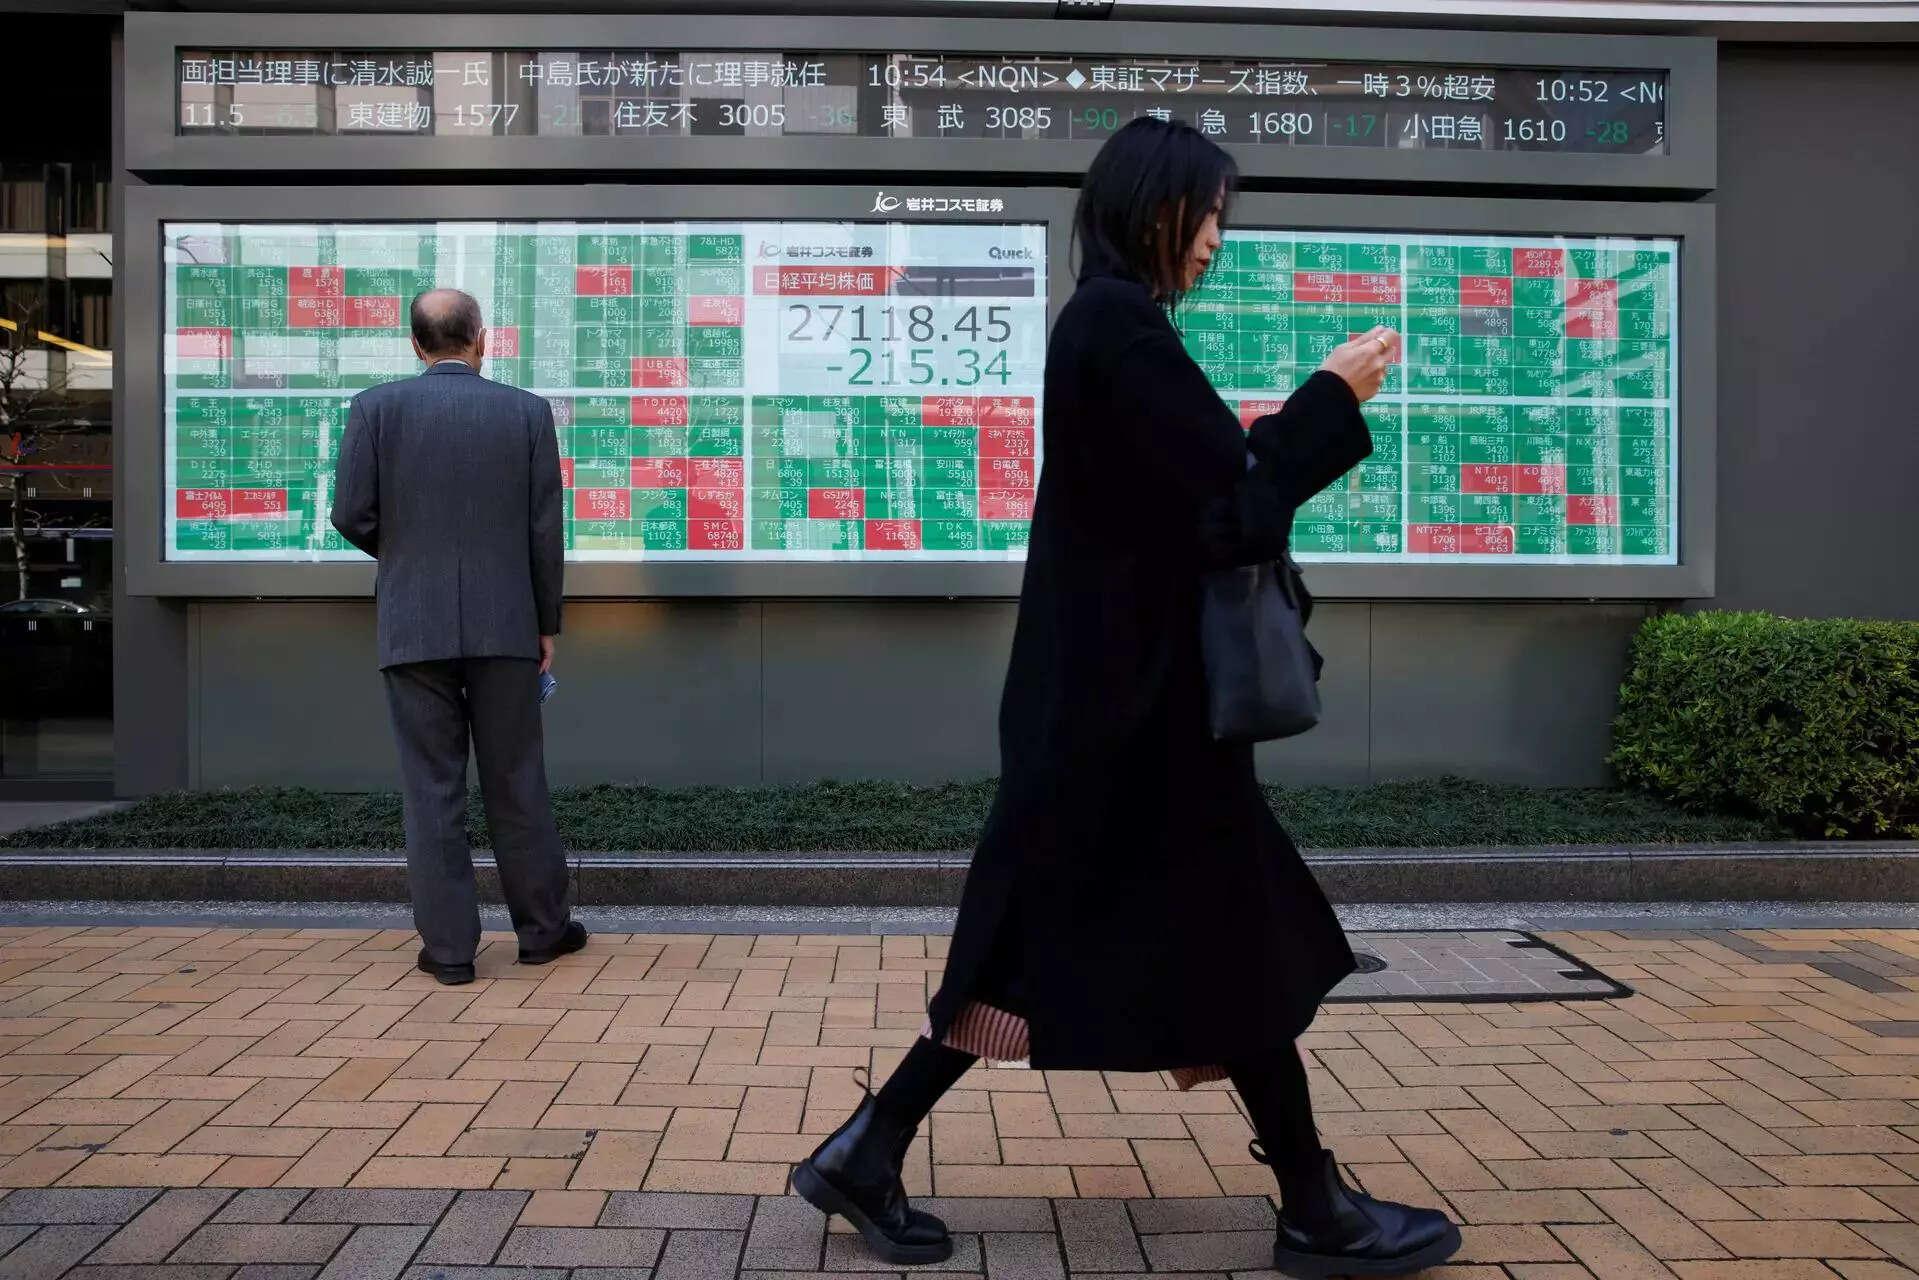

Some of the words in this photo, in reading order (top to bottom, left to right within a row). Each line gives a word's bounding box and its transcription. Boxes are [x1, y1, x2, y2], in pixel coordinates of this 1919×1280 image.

[182, 60, 488, 87] 画担当理事に清水誠一氏
[519, 60, 827, 88] 中島氏が新たに理事就任
[868, 64, 947, 87] 10:54
[958, 65, 1060, 92] <NQN>
[1536, 80, 1609, 102] 10:52
[1619, 84, 1663, 103] <N
[185, 104, 244, 126] 11.5
[347, 102, 432, 129] 東建物
[453, 105, 519, 128] 1577
[614, 101, 699, 129] 住友不
[719, 105, 786, 128] 3005
[983, 107, 1052, 131] 3085
[1072, 109, 1118, 131] -90
[1249, 112, 1313, 135] 1680
[1333, 115, 1376, 137] -17
[1403, 113, 1483, 141] 小田急
[1504, 119, 1567, 142] 1610
[1586, 121, 1628, 144] -28
[906, 198, 1004, 212] 岩井コスモ証券
[786, 245, 873, 258] 岩井コスモ証券
[764, 272, 875, 291] 日経平均株価
[1488, 287, 1508, 297] 974
[1430, 295, 1456, 305] -15.0
[1214, 312, 1234, 321] 862
[1263, 313, 1289, 323] 4498
[1318, 314, 1343, 324] 2710
[787, 304, 1012, 343] 27118.45
[1217, 320, 1234, 329] -14
[1271, 321, 1289, 331] -22
[1484, 318, 1508, 327] 4895
[1332, 323, 1343, 332] -9
[1500, 326, 1508, 336] 0
[1206, 342, 1234, 352] 465.4
[1214, 351, 1234, 360] -5.3
[1278, 352, 1289, 362] -7
[826, 349, 1012, 386] -215.34
[642, 398, 677, 408] TOTO
[201, 409, 226, 418] 5129
[257, 409, 282, 418] 4343
[601, 409, 626, 418] 1214
[656, 409, 682, 418] 4420
[1379, 413, 1397, 423] 847
[210, 417, 227, 426] -49
[266, 417, 282, 426] -37
[663, 417, 682, 426] +15
[899, 417, 916, 426] -12
[949, 417, 973, 426] +2.0
[1010, 417, 1031, 426] +50
[1387, 422, 1398, 431] -7
[880, 430, 907, 438] NTN
[201, 440, 226, 449] 3327
[601, 438, 626, 448] 1592
[658, 438, 682, 448] 1823
[714, 438, 738, 448] 2341
[897, 438, 917, 448] 317
[953, 438, 973, 448] 959
[1004, 439, 1029, 448] 2337
[210, 448, 226, 457] -39
[609, 447, 626, 456] -18
[721, 447, 738, 456] -23
[962, 447, 973, 456] -1
[1009, 447, 1030, 457] +14
[1431, 444, 1456, 454] 3212
[1484, 445, 1509, 455] 3420
[1378, 452, 1398, 461] -7.2
[1434, 453, 1456, 462] -102
[1488, 453, 1509, 463] -110
[657, 469, 682, 479] 2062
[777, 469, 803, 478] 6806
[947, 469, 973, 479] 5510
[1004, 469, 1029, 479] 6501
[1474, 466, 1498, 475] NTT
[609, 478, 626, 487] -19
[667, 478, 682, 487] +7
[786, 478, 802, 487] -39
[956, 478, 973, 487] -20
[1009, 478, 1030, 487] +73
[1362, 473, 1398, 483] 2348.0
[1431, 475, 1456, 484] 3130
[1484, 475, 1509, 485] 4012
[1494, 484, 1509, 493] +6
[641, 490, 678, 500] フジクラ
[761, 490, 798, 500] オムロン
[988, 490, 1025, 500] エプソン
[201, 500, 227, 510] 6495
[263, 500, 281, 510] 551
[591, 501, 626, 510] 1592.5
[662, 501, 682, 510] 883
[719, 500, 739, 510] 932
[778, 499, 803, 509] 7405
[834, 499, 860, 509] 2245
[208, 509, 227, 519] +37
[601, 509, 627, 518] +2.5
[670, 509, 682, 518] -3
[725, 509, 739, 518] +2
[786, 509, 803, 518] -34
[838, 509, 860, 518] +15
[956, 509, 973, 518] -40
[1008, 509, 1029, 518] +21
[1431, 505, 1456, 514] 1396
[1485, 505, 1508, 515] 1261
[1323, 512, 1344, 521] -6.5
[1440, 513, 1456, 522] -12
[703, 521, 730, 531] SMC
[938, 521, 963, 530] TDK
[648, 531, 682, 541] 1102.5
[707, 531, 739, 541] 68740
[948, 531, 973, 541] 4485
[1319, 534, 1344, 544] 1609
[1484, 534, 1509, 544] 8064
[209, 540, 226, 549] -23
[661, 540, 682, 549] -6.5
[712, 540, 739, 549] +170
[902, 540, 917, 549] +5
[956, 540, 973, 549] -50
[1442, 543, 1456, 552] +5
[1488, 543, 1509, 553] +63
